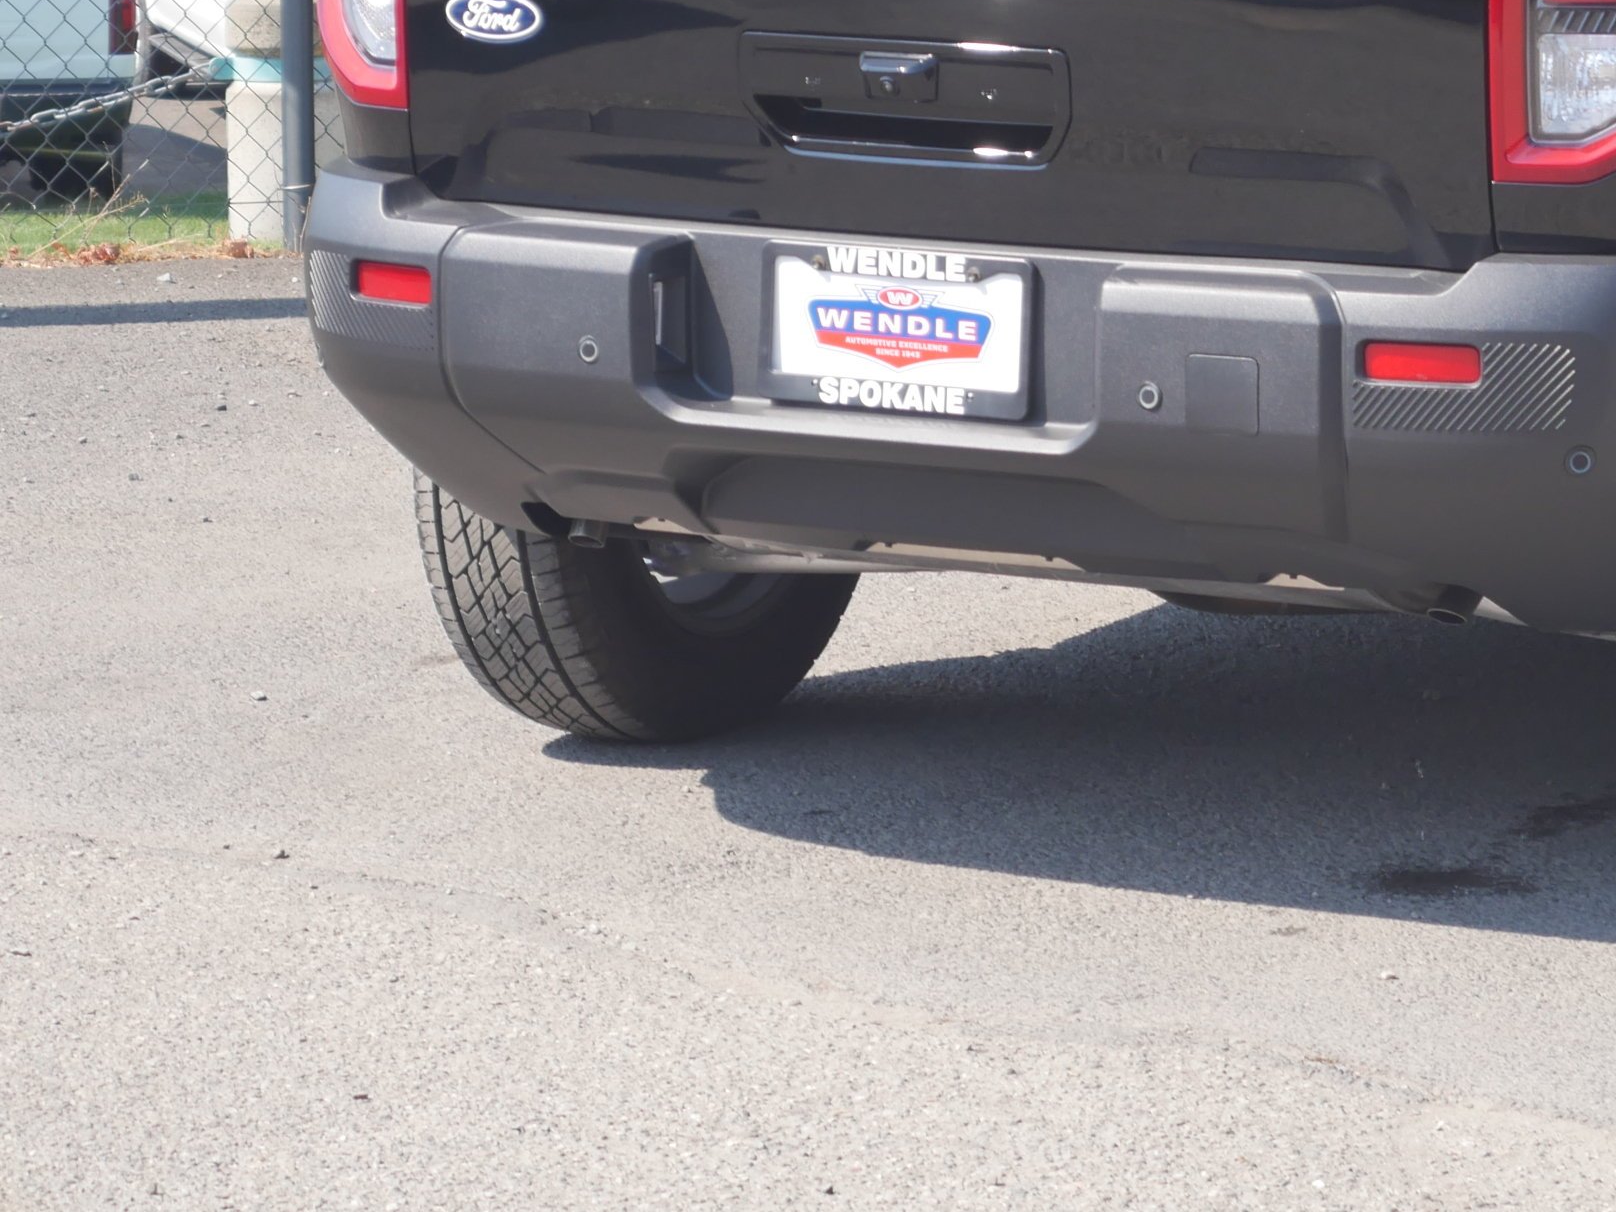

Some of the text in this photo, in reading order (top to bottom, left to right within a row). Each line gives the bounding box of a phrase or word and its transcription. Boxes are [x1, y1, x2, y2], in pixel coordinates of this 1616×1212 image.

[826, 246, 967, 283] WENDLE
[816, 307, 978, 341] WENDLE
[845, 336, 949, 353] AUTOMOTIVE EXCELLENCE
[875, 347, 901, 358] SINCE
[818, 376, 965, 415] SPOKANE
